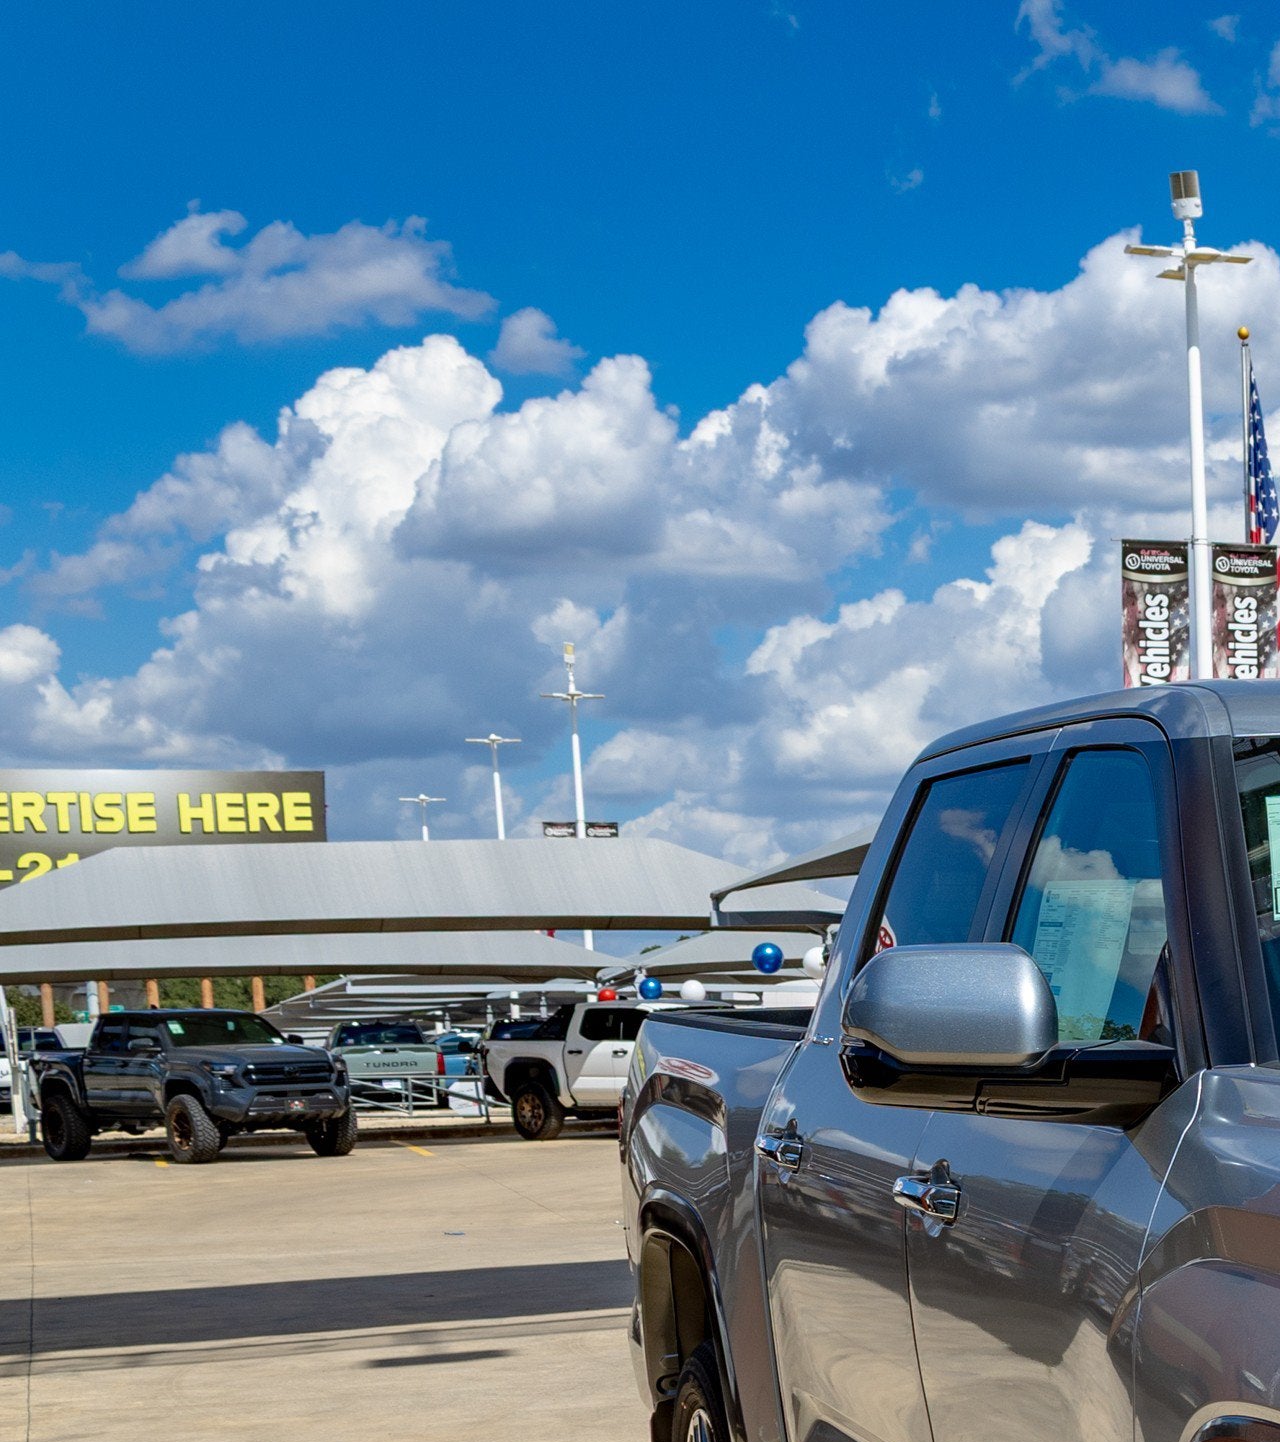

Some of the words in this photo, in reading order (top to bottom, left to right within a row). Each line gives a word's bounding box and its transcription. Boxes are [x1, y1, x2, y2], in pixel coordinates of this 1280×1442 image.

[1140, 555, 1184, 564] UNIVERSAL
[1230, 558, 1273, 568] UNIVERSAL
[1141, 563, 1171, 571] TOYOTA
[1230, 566, 1259, 574] TOYOTA
[1228, 596, 1259, 679] ehicles
[177, 792, 313, 833] HERE
[365, 1061, 418, 1069] TUNDRA
